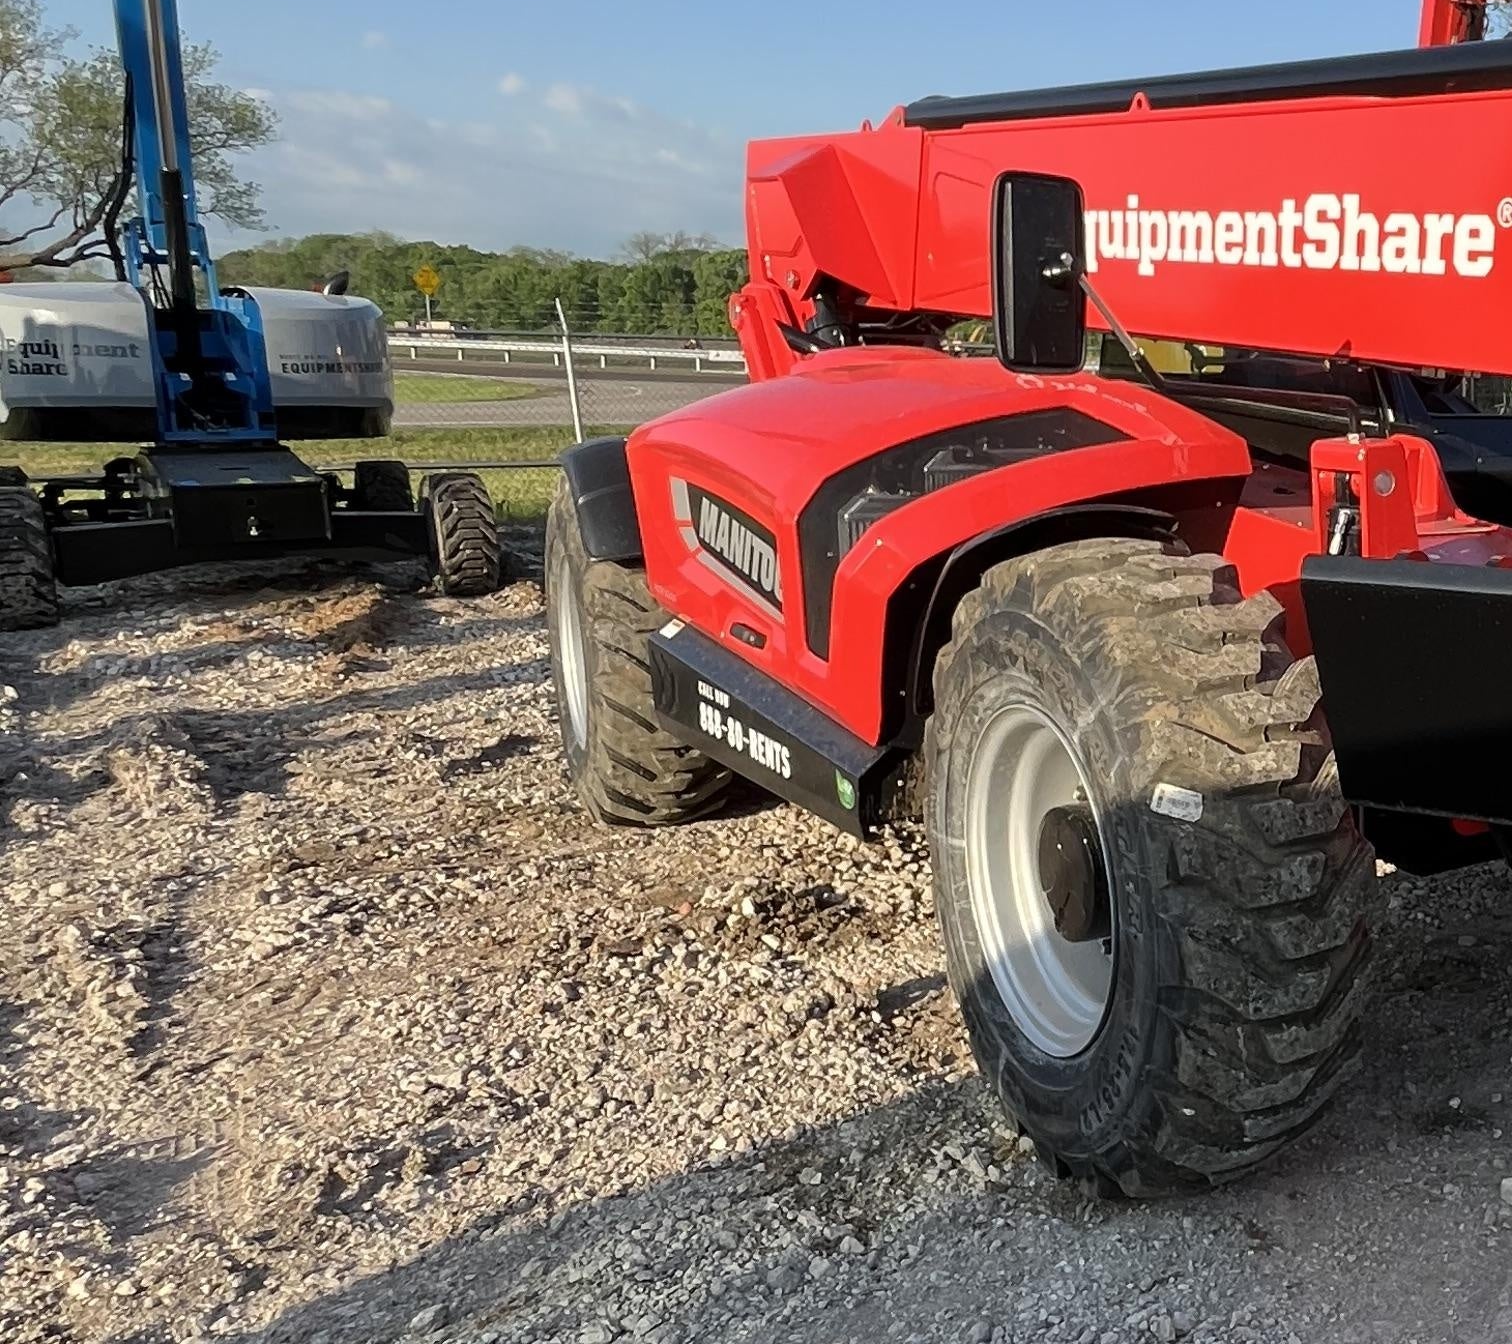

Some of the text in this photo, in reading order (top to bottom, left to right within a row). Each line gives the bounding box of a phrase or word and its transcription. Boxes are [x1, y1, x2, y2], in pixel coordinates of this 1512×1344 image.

[7, 358, 69, 376] Share
[698, 680, 714, 701] CALL
[699, 701, 792, 779] 888-80-RENTS
